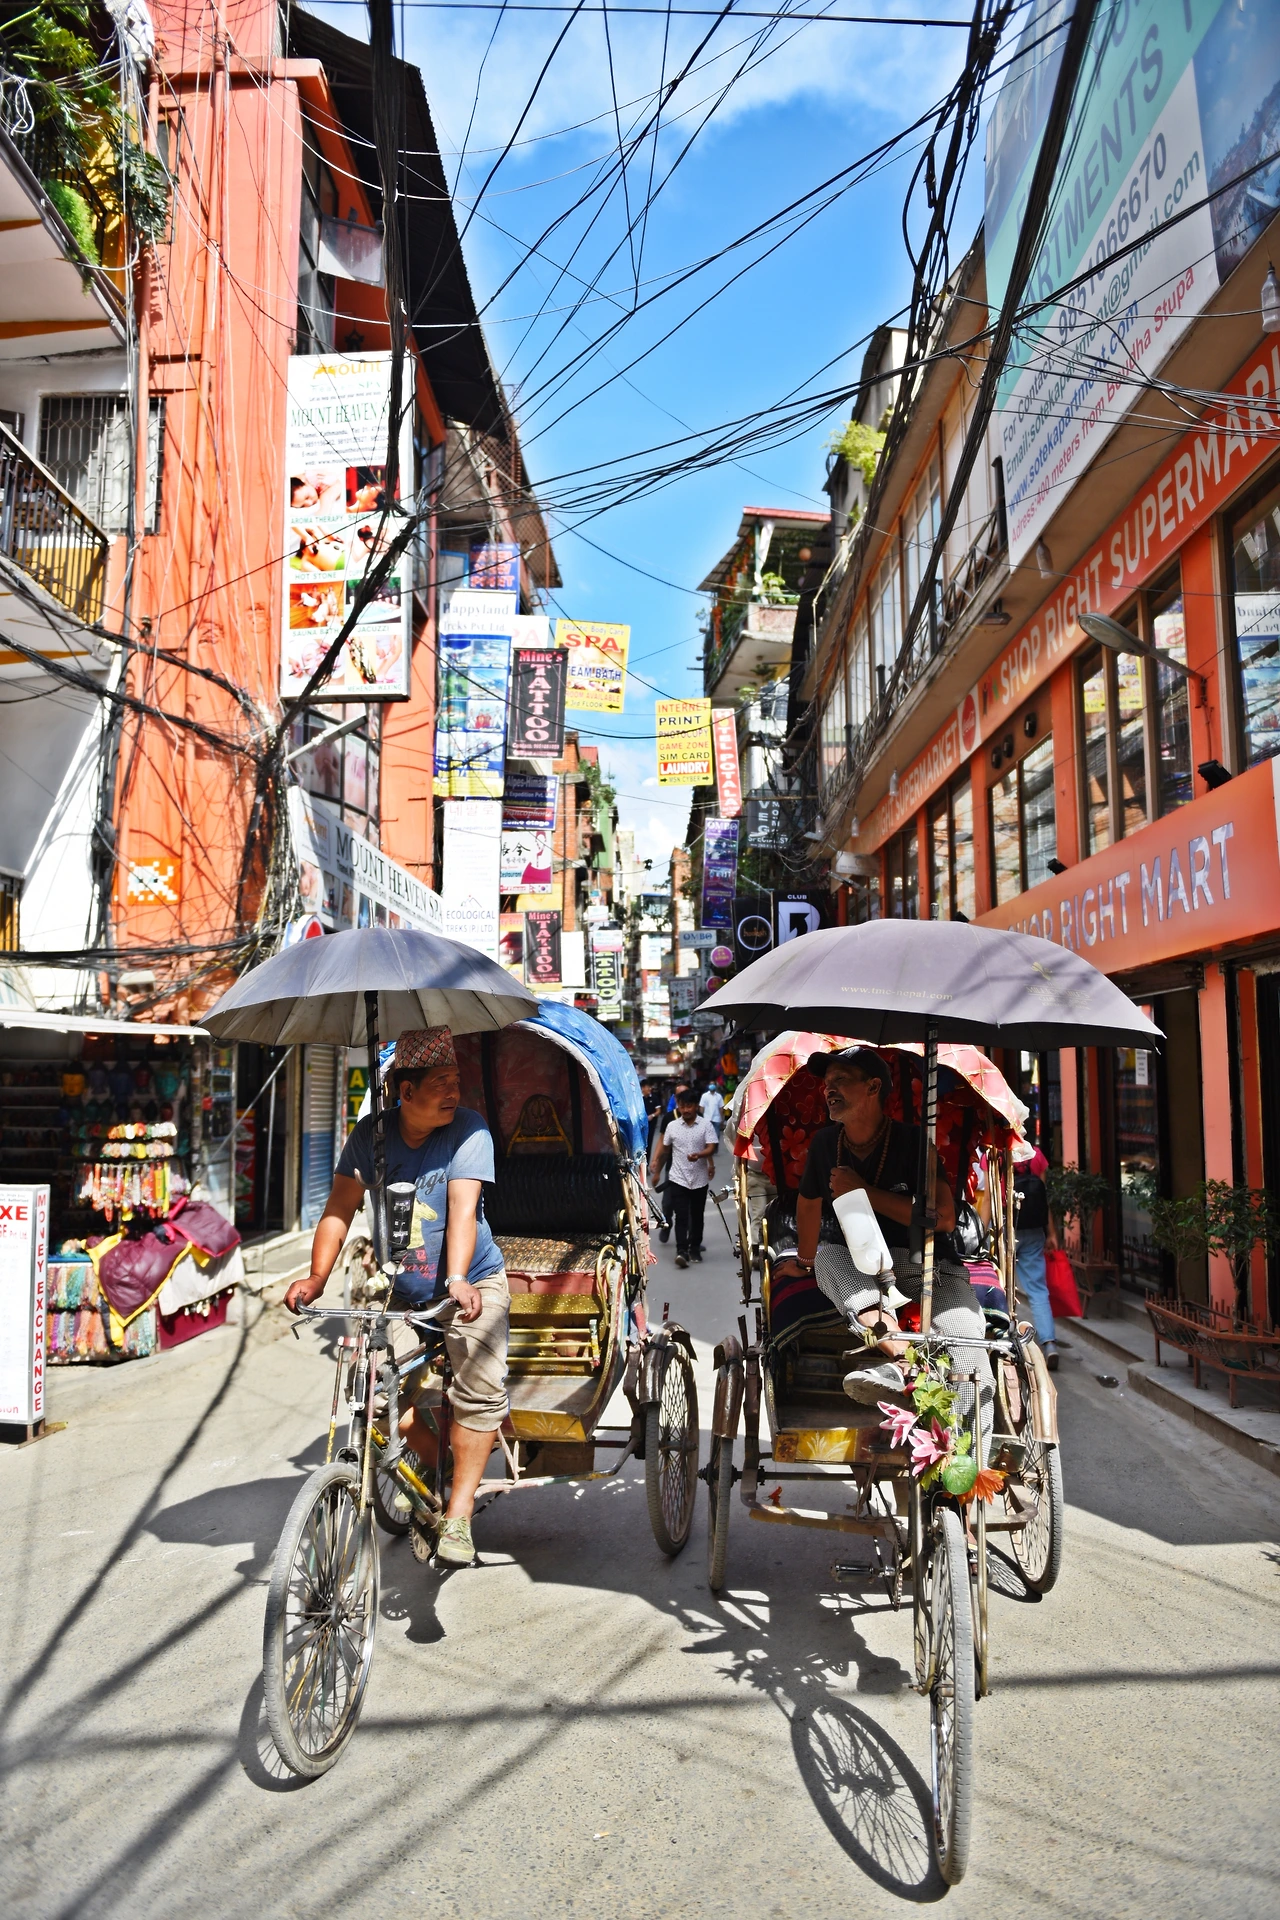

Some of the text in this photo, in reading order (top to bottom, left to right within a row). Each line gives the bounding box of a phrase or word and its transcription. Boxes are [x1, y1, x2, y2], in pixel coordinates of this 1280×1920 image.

[1051, 431, 1082, 484] meters
[1154, 267, 1195, 334] Stupa
[291, 406, 332, 428] MOUNT
[336, 402, 378, 423] HEAVEN
[1003, 421, 1017, 452] For
[291, 514, 343, 524] AROMA THERAPY
[1000, 633, 1042, 706] SHOP
[1045, 553, 1104, 657] RIGHT
[564, 633, 621, 653] SPA
[519, 650, 563, 662] Mine's
[595, 668, 622, 680] BATH
[348, 684, 402, 692] MEHENDI WAXING
[524, 663, 552, 742] TATTOO
[586, 692, 620, 702] AVAILABLE
[658, 702, 708, 713] INTERNET
[659, 715, 702, 726] PRINT
[660, 728, 708, 739] PHOTOCOPY
[715, 710, 733, 750] HOTEL
[659, 740, 709, 751] GAME ZONE
[660, 751, 710, 761] SIM CARD
[660, 761, 709, 775] LAUNDRY
[896, 721, 958, 822] SUPERMARKET
[720, 753, 739, 806] POTALA
[758, 801, 770, 833] VEG
[336, 825, 385, 886] MOUNT
[388, 864, 429, 913] HEAVEN
[1060, 870, 1131, 951] RIGHT
[1140, 821, 1235, 929] MART
[446, 910, 496, 920] ECOLOGICAL
[528, 911, 558, 920] Mine's
[446, 924, 468, 932] TREKS
[536, 920, 554, 973] TATTOO
[841, 986, 953, 1002] www.tmc-nepal.com
[34, 1195, 47, 1412] MONEY EXCHANGE
